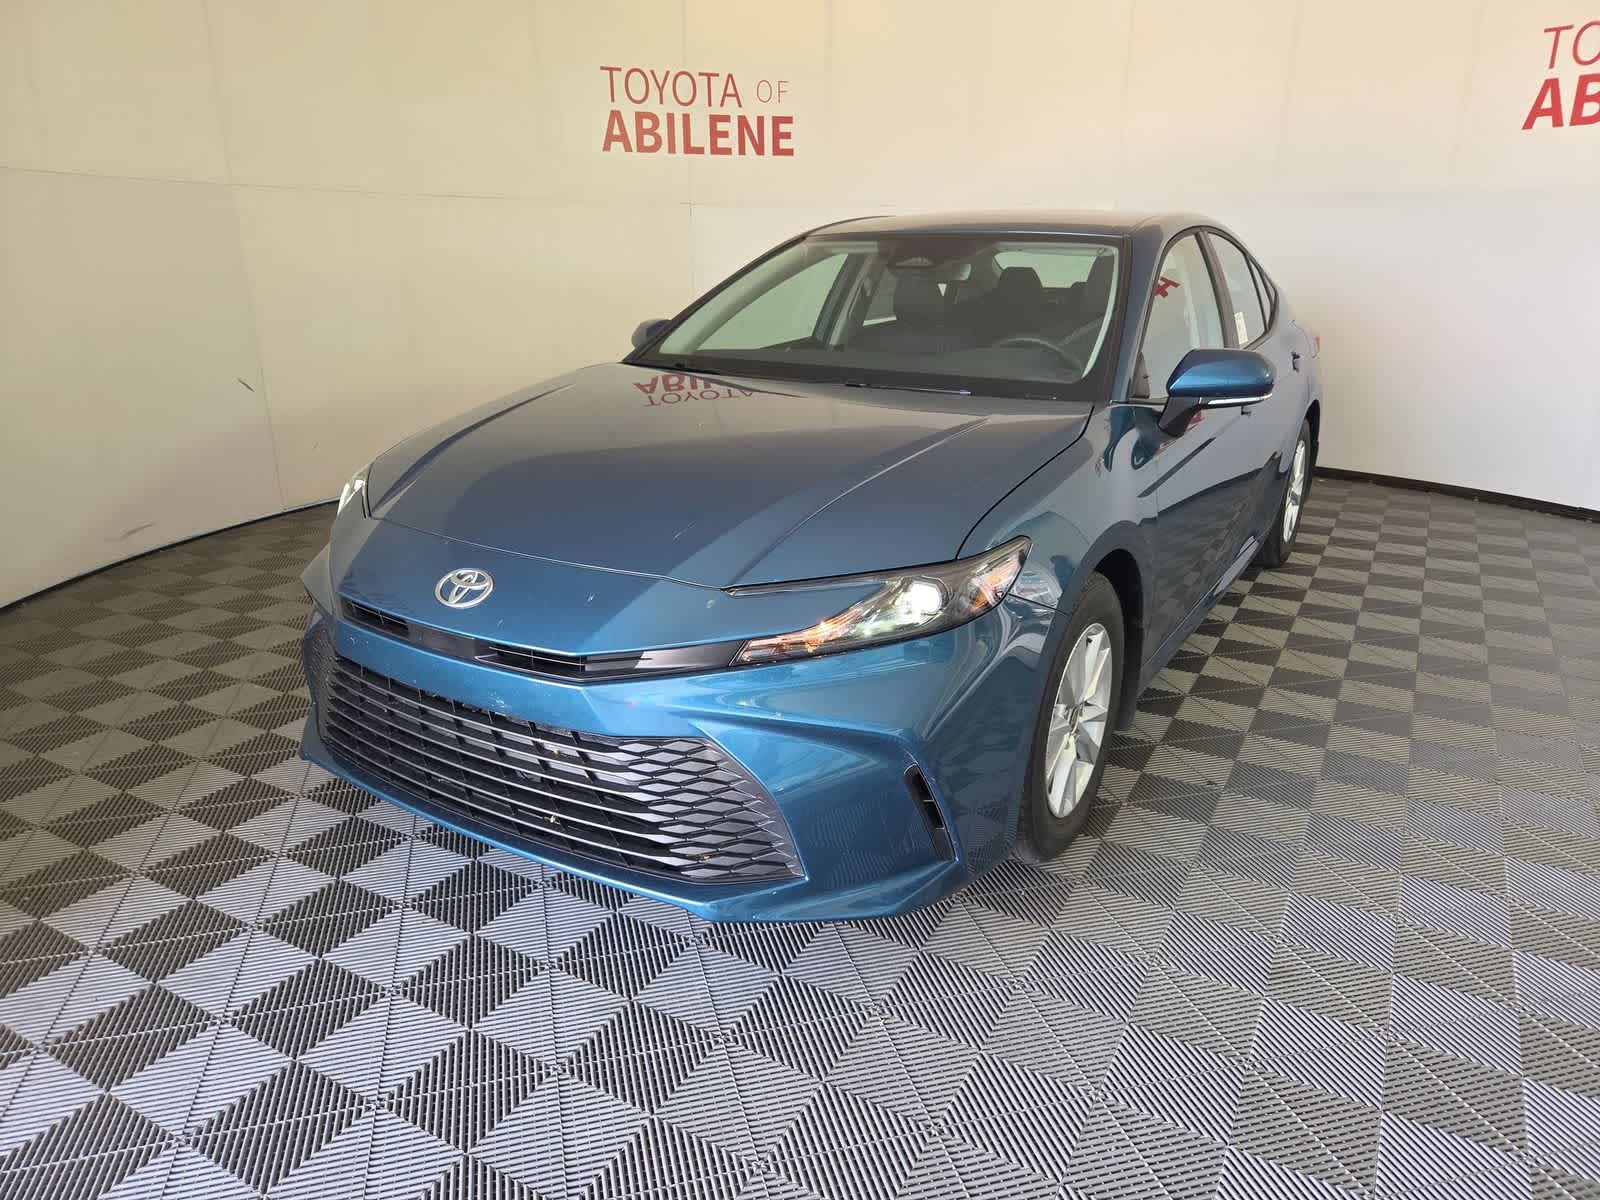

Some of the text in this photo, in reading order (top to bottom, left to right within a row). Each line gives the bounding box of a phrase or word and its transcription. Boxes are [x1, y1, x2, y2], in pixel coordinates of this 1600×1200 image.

[600, 66, 789, 108] TOYOTA OF
[1521, 73, 1600, 130] AB
[602, 109, 794, 156] ABILENE
